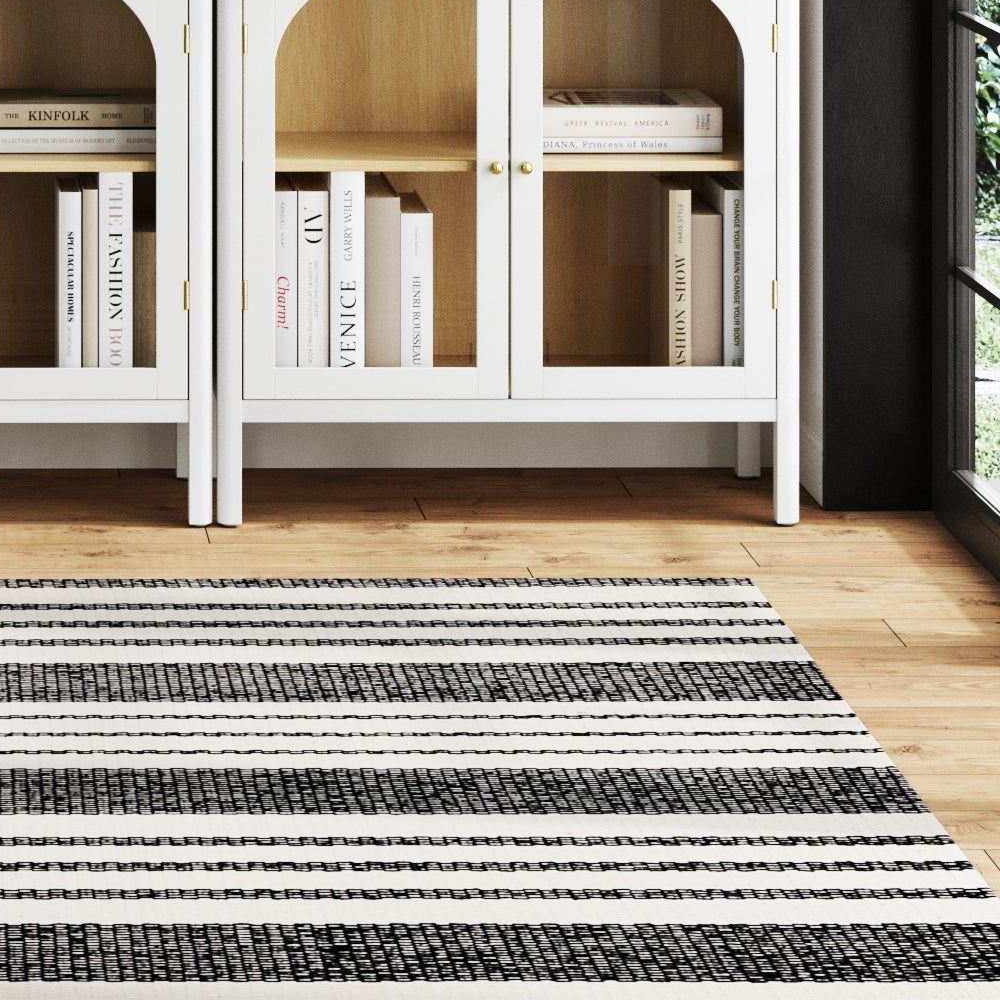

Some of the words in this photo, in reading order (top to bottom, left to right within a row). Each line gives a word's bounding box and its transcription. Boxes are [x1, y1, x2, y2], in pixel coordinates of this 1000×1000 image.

[28, 110, 89, 121] KINFOLK
[543, 141, 578, 149] DIANA,
[109, 183, 122, 225] THE
[344, 190, 353, 223] WILLS
[304, 207, 323, 244] AD
[344, 227, 353, 261] GARRY
[109, 232, 122, 320] FASHION
[412, 276, 421, 307] HENRI
[675, 255, 686, 302] SHOW
[277, 276, 290, 329] Charm!
[340, 280, 356, 367] VENICE
[412, 311, 421, 365] ROUSSEAU
[675, 310, 686, 366] ASHION
[109, 328, 122, 366] BOO
